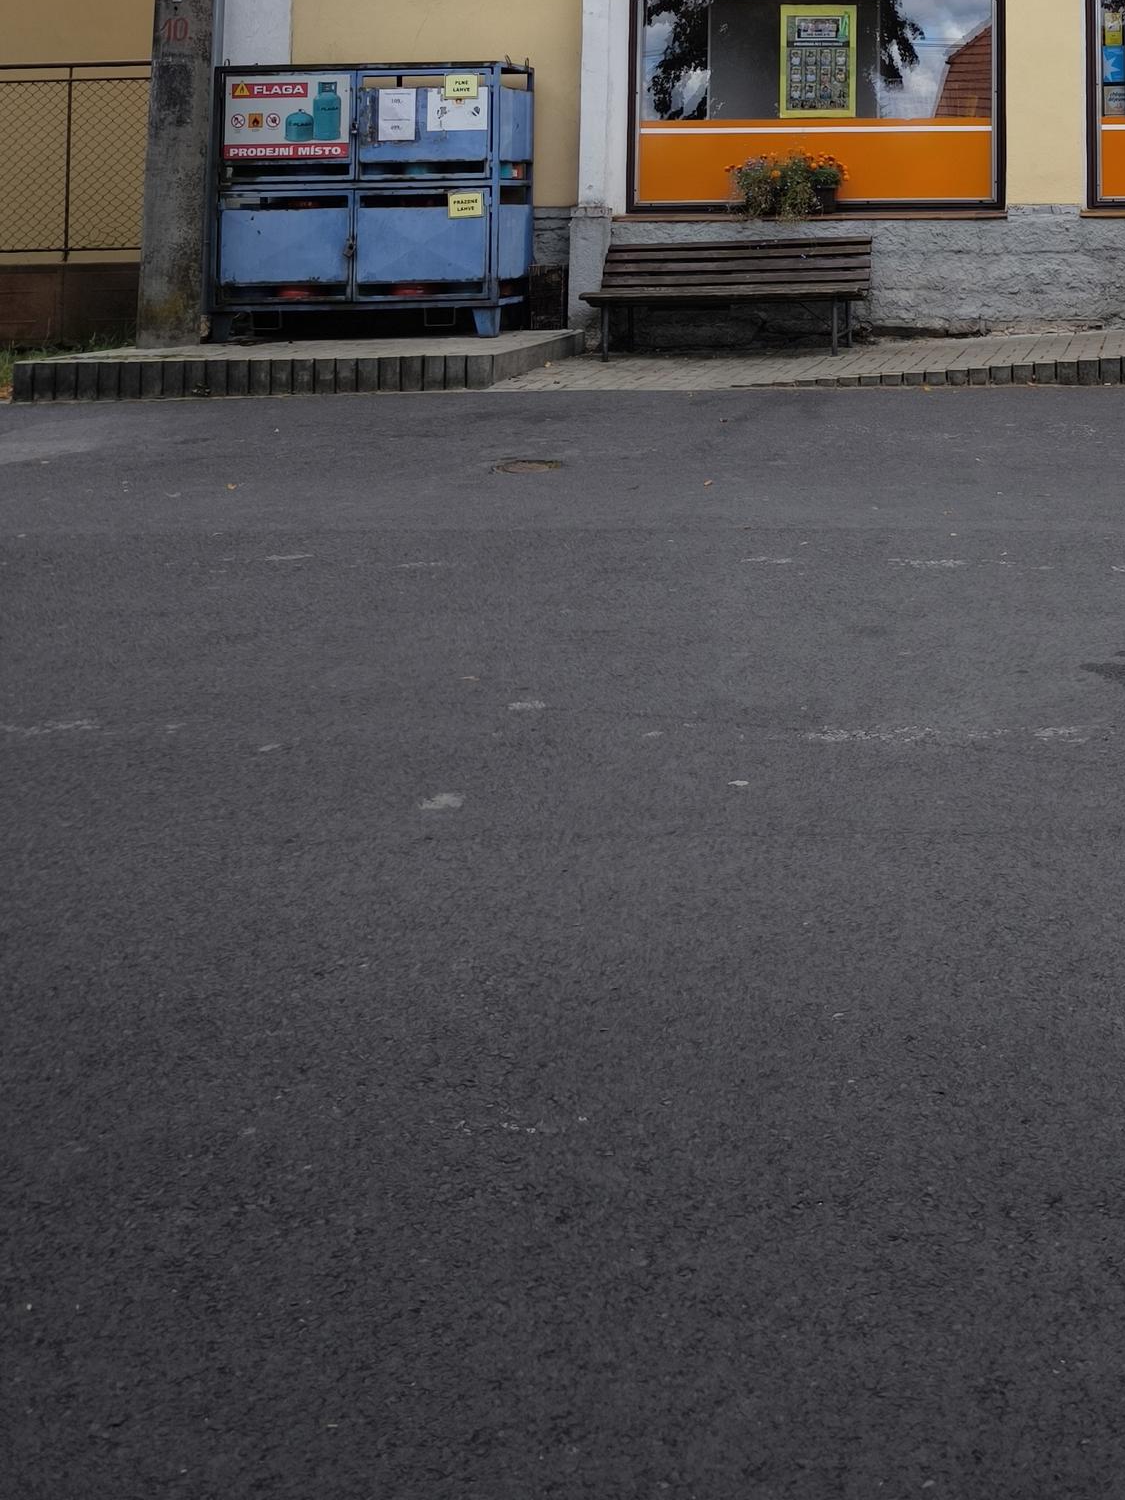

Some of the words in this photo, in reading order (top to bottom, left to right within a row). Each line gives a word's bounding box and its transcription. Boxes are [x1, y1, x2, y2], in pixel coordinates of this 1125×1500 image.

[254, 85, 305, 95] FLAGA
[229, 146, 293, 157] PRODEJNÍ
[298, 145, 341, 155] MÍSTO
